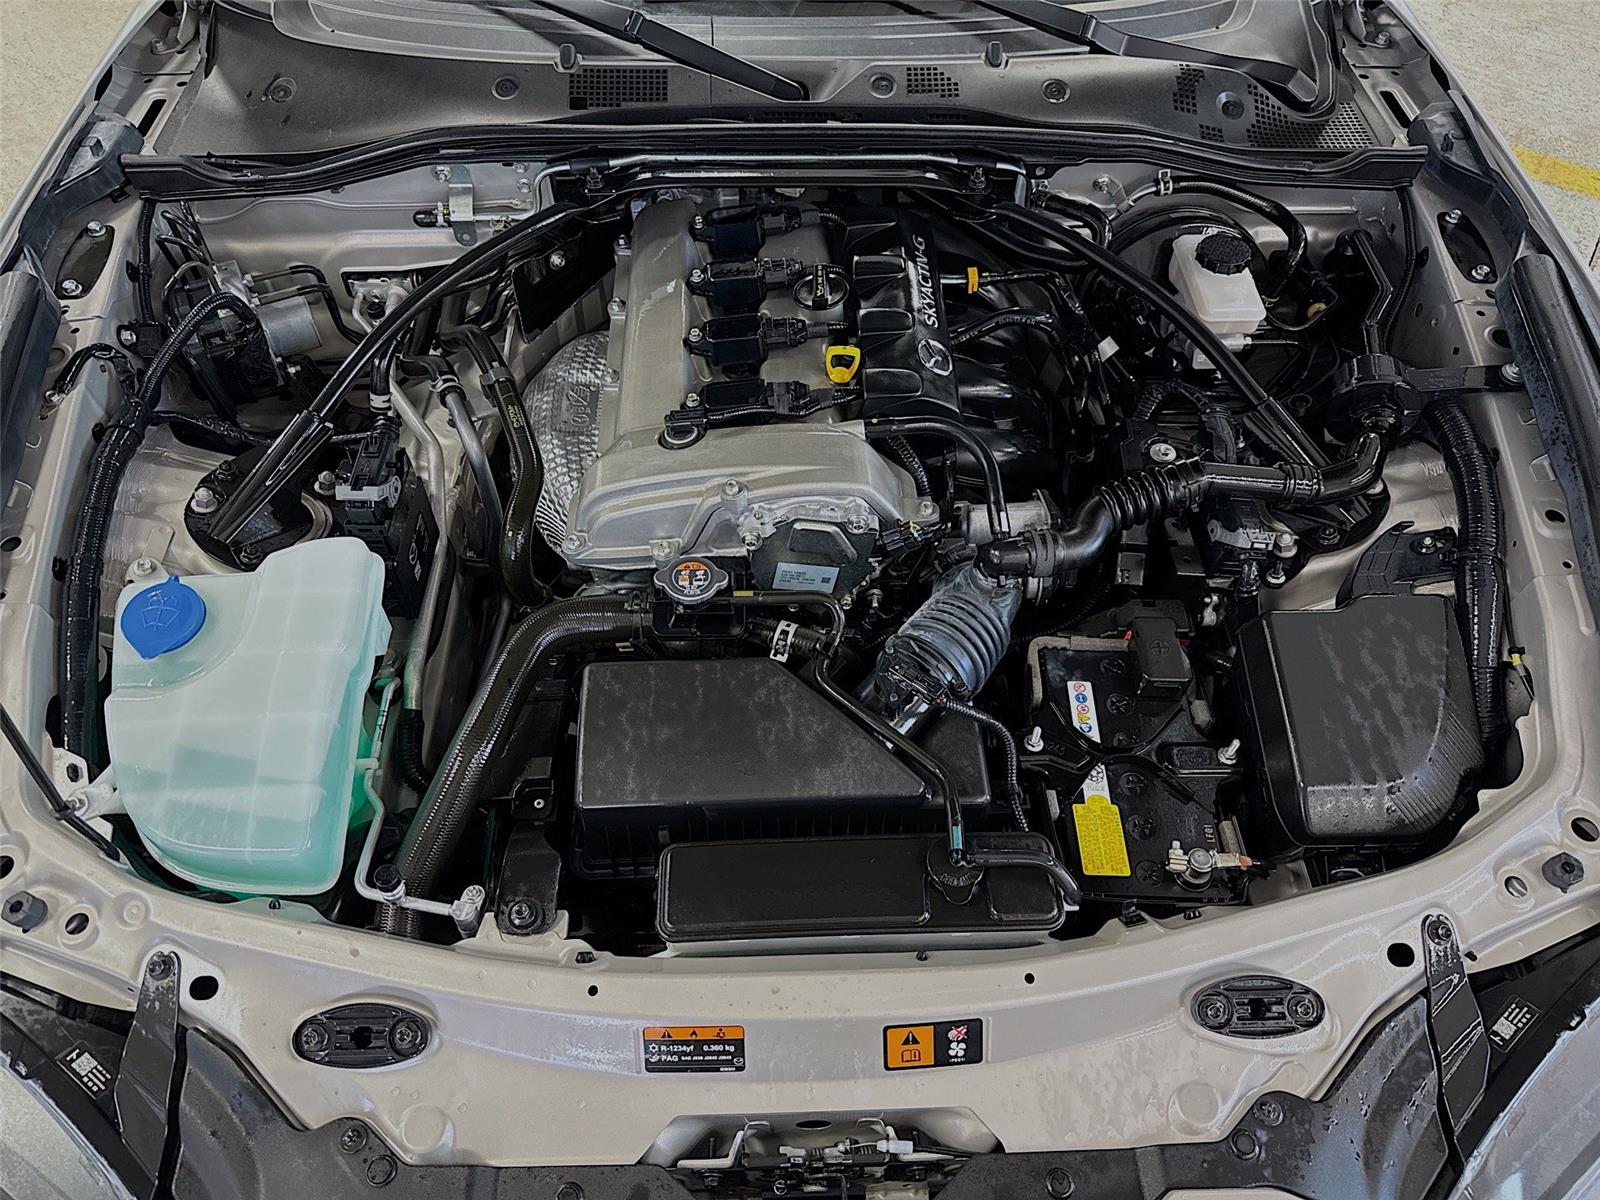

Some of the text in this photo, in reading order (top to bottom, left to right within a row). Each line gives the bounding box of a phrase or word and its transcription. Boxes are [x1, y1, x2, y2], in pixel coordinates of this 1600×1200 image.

[912, 233, 939, 329] SKYACTIV-G
[660, 1044, 694, 1053] R-1234yf
[724, 1044, 735, 1053] kg
[661, 1054, 679, 1062] PAG
